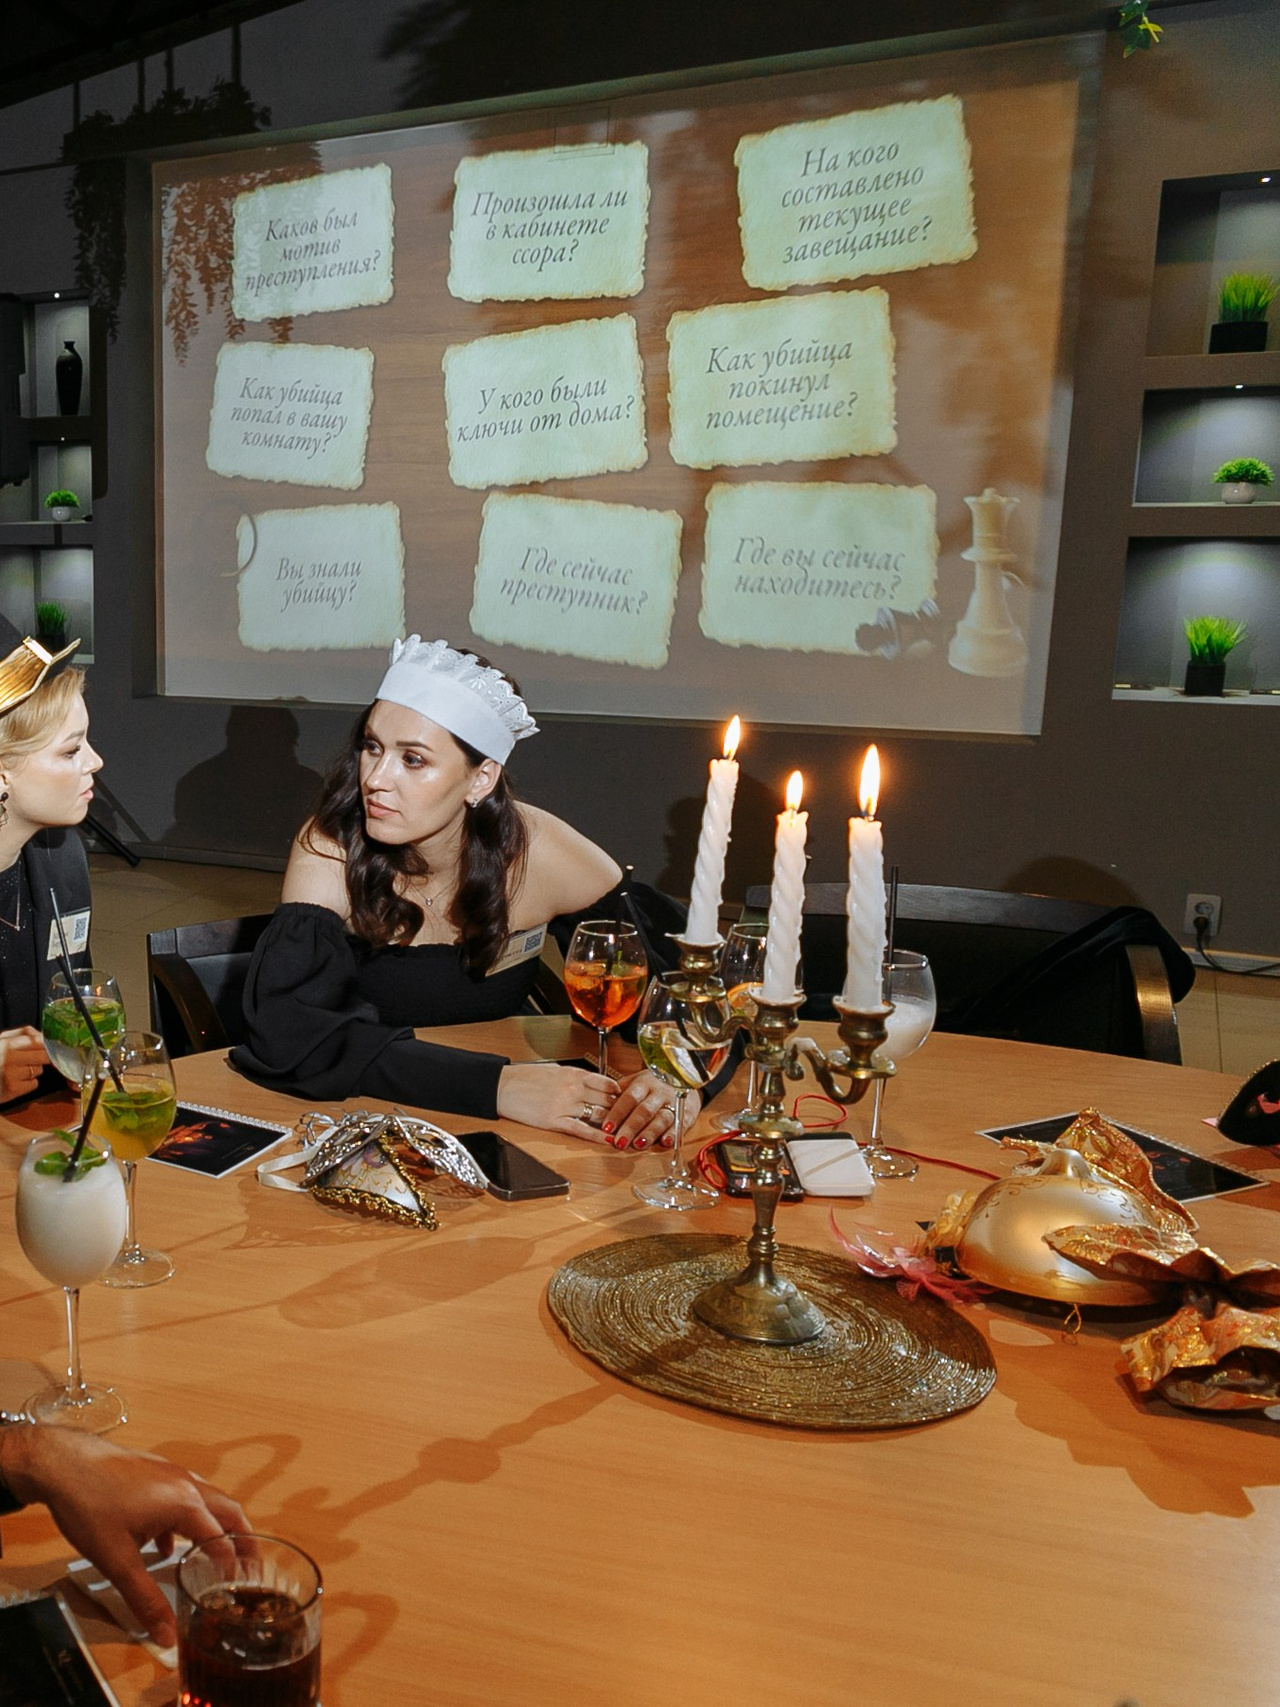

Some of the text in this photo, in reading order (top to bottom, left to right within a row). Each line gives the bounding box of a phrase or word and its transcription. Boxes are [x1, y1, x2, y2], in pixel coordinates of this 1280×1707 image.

[801, 143, 899, 177] На кого
[782, 166, 924, 208] составлено
[471, 190, 628, 223] Произошла ли
[799, 198, 912, 234] текущее
[265, 207, 358, 242] Каков был
[486, 212, 610, 240] в кабинете
[783, 215, 932, 264] завещание?
[279, 239, 341, 262] мотив
[513, 239, 579, 272] ссора?
[245, 249, 381, 297] преступления?
[706, 338, 853, 377] Как убийца
[239, 377, 343, 411] Как убийца
[478, 375, 607, 414] У кого были
[729, 373, 830, 402] покинул
[231, 406, 348, 439] попал в вашу
[457, 395, 635, 442] ключи от дома?
[706, 391, 858, 431] помещение?
[242, 431, 332, 460] комнату?
[276, 557, 362, 581] Вы знали
[520, 546, 633, 586] Где сейчас
[733, 536, 906, 572] Где вы сейчас
[280, 579, 357, 613] убийцу?
[500, 578, 648, 615] преступник?
[734, 567, 902, 600] находитесь?
